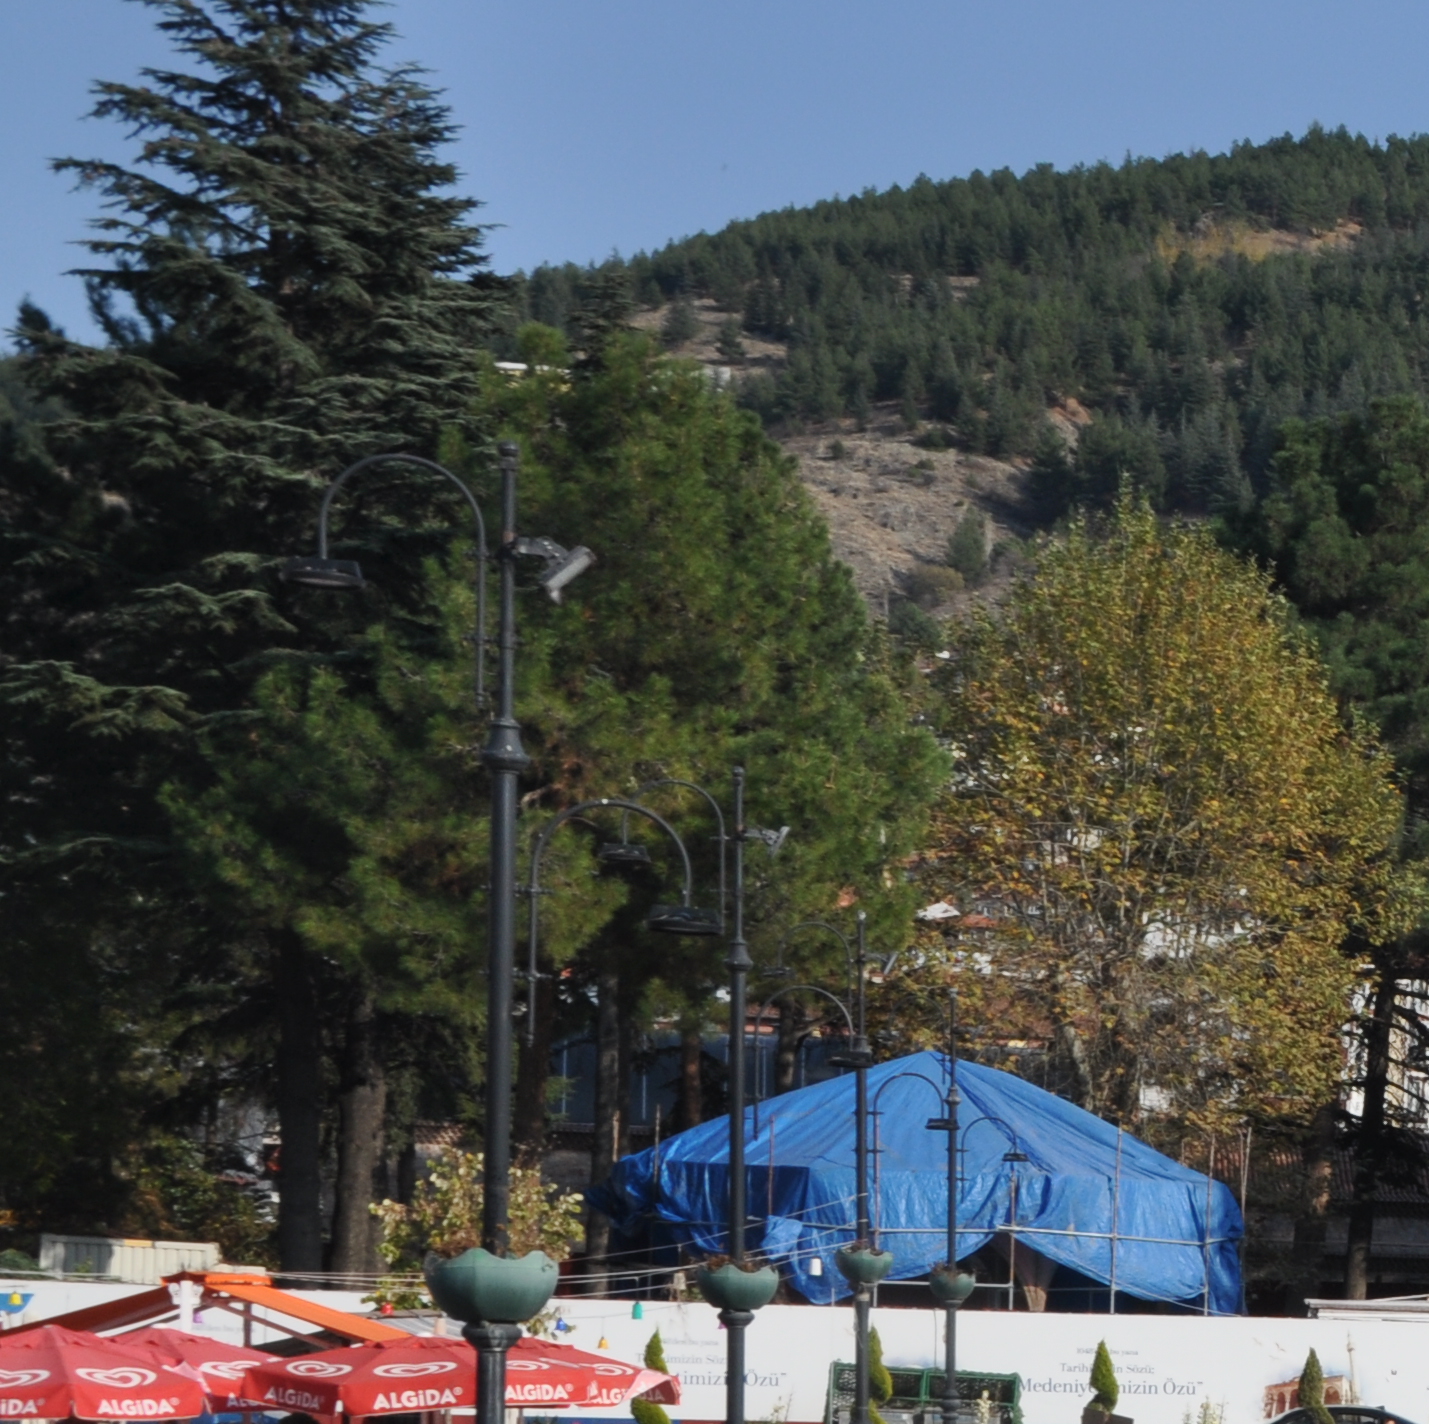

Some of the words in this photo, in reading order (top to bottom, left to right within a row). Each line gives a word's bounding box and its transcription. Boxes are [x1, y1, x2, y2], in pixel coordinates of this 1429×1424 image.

[705, 1353, 725, 1364] Söz
[98, 1399, 176, 1416] ALGiDA
[373, 1388, 457, 1410] ALGiDA
